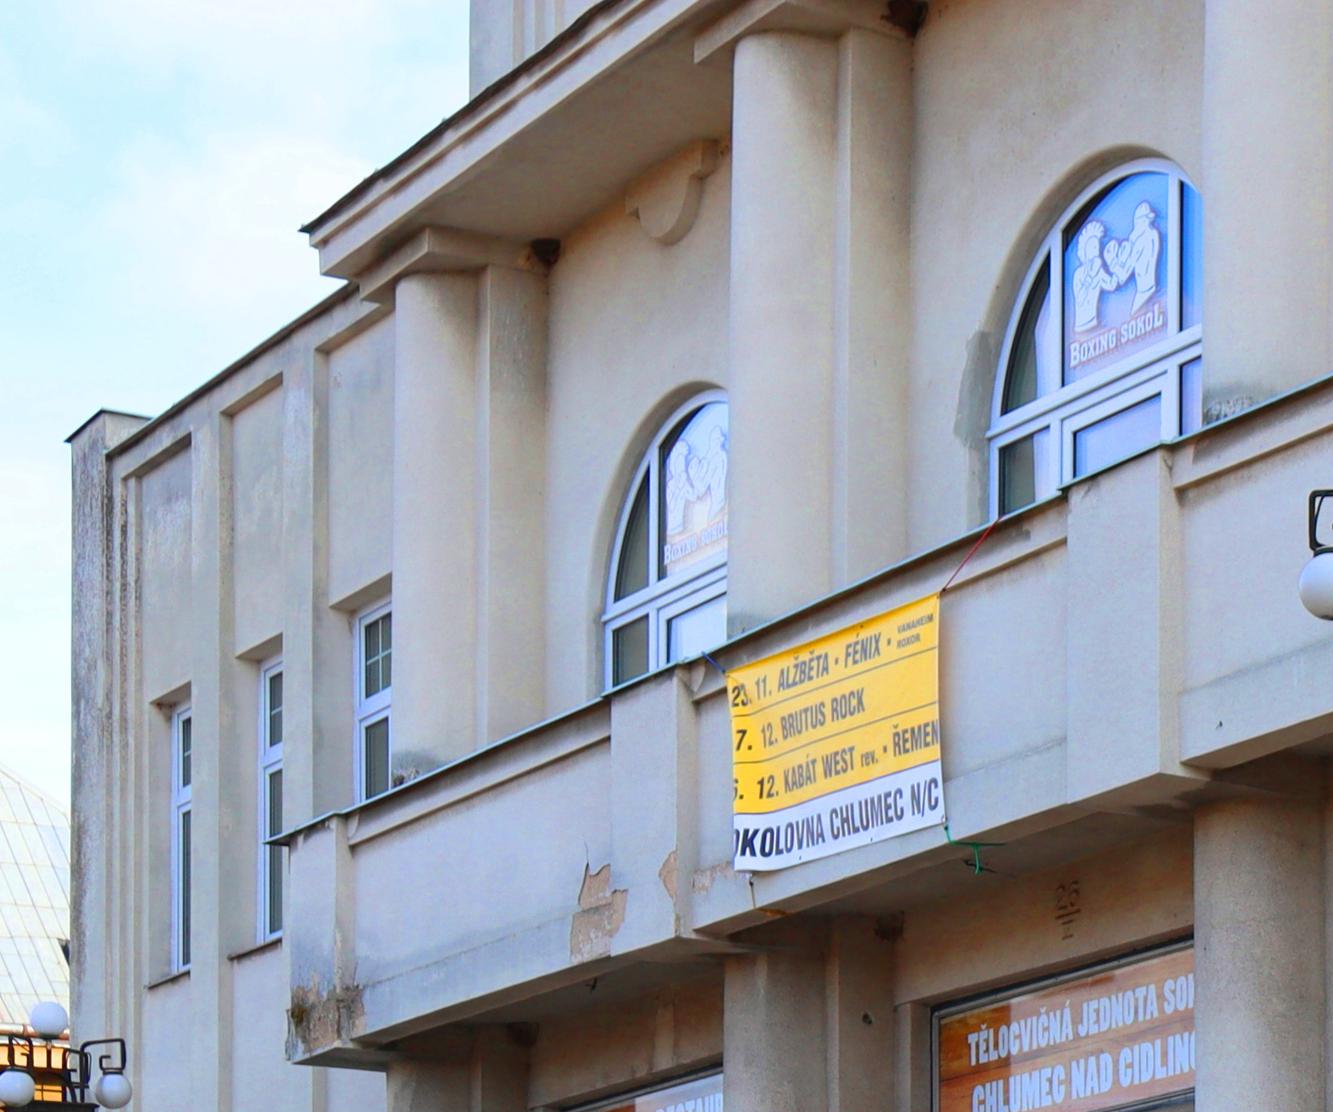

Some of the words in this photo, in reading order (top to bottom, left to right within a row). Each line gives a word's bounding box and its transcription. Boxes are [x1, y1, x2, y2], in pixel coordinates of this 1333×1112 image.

[754, 674, 773, 701] 11.
[777, 649, 830, 693] ALŽBĚTA
[843, 632, 882, 668] FÉNIX
[735, 728, 753, 752] 7.
[760, 722, 779, 749] 12.
[780, 701, 826, 741] BRUTUS
[831, 687, 866, 722] ROCK
[757, 776, 779, 801] 12.
[783, 752, 817, 793] KABÁT
[821, 746, 856, 779] WEST
[860, 750, 879, 768] rev.
[829, 787, 905, 840] CHLUMEC
[911, 777, 939, 818] N/C
[967, 1000, 1074, 1066] TĚLOCVIČNÁ
[1077, 983, 1159, 1038] JEDNOTA
[1071, 1052, 1113, 1100] NAD
